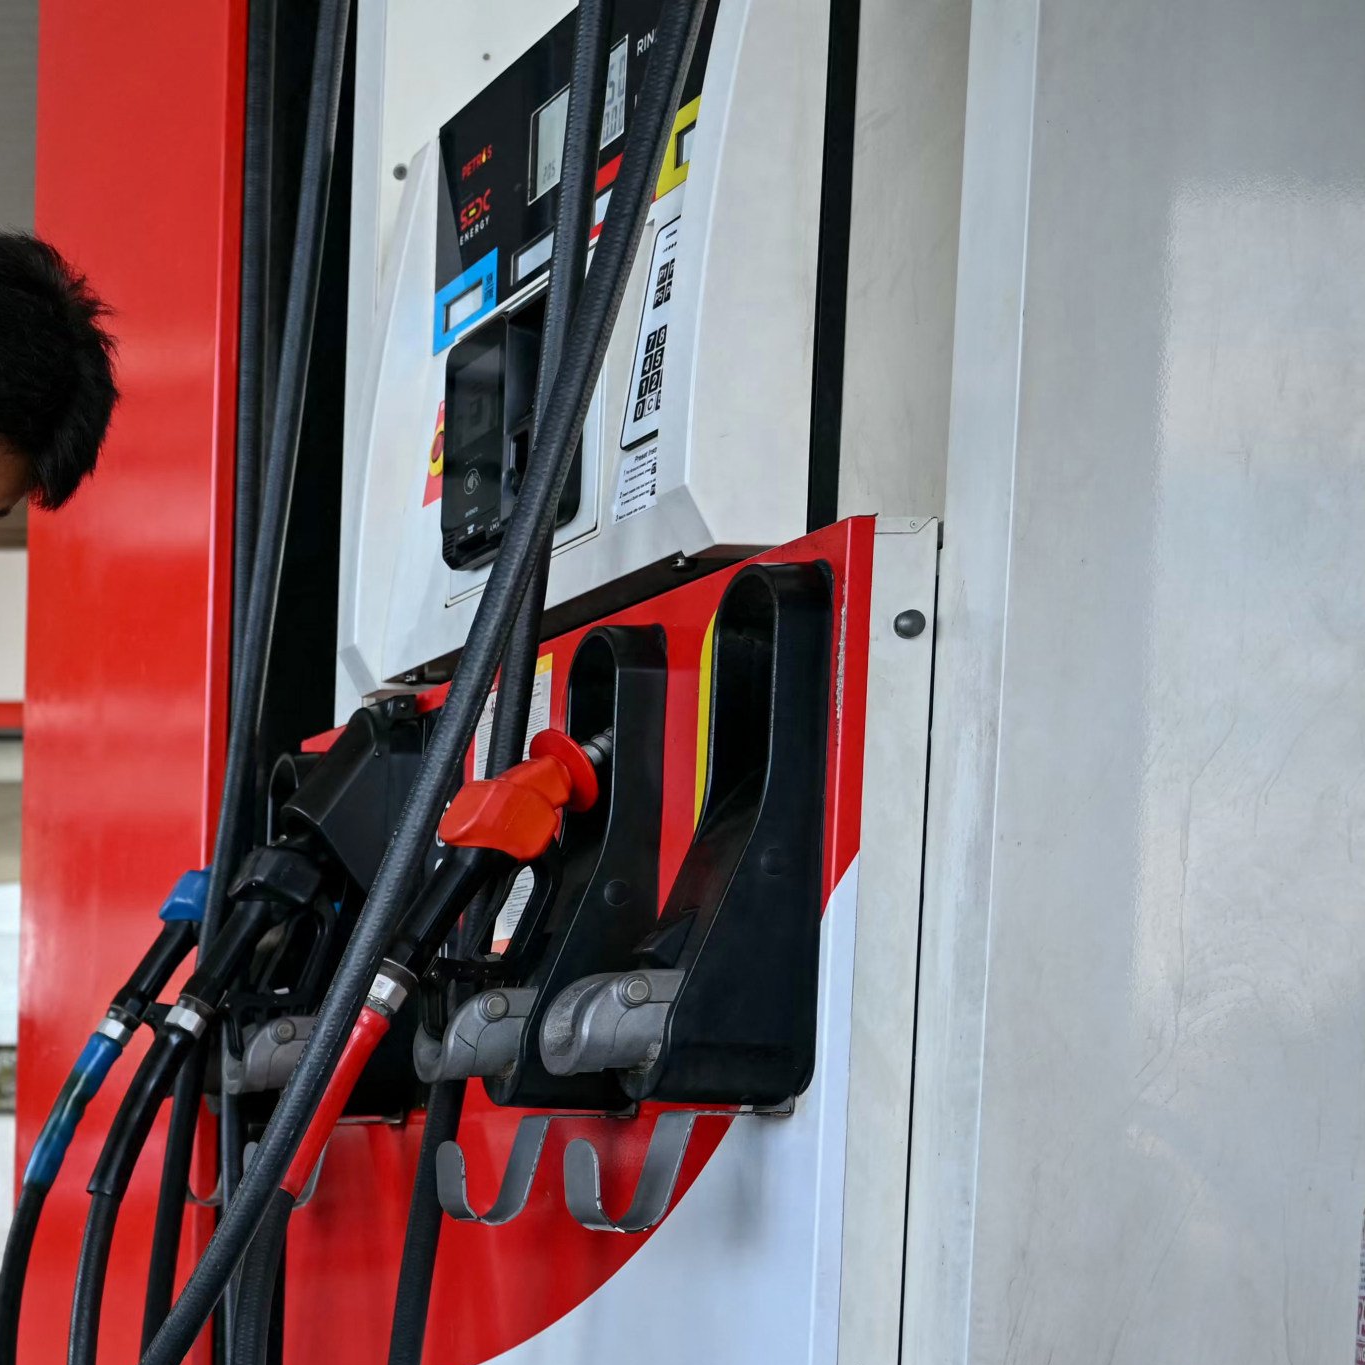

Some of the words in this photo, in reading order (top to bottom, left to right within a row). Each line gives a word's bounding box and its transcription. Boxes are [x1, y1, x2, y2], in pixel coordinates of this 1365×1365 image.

[636, 29, 658, 56] RIN
[460, 187, 492, 231] SEDC
[459, 215, 491, 246] ENERGY
[648, 333, 655, 349] 7
[658, 328, 666, 344] 8
[643, 357, 651, 373] 4
[654, 350, 662, 367] 5
[641, 380, 648, 396] 1
[651, 374, 658, 390] 2
[636, 402, 643, 418] 0
[647, 397, 654, 411] C
